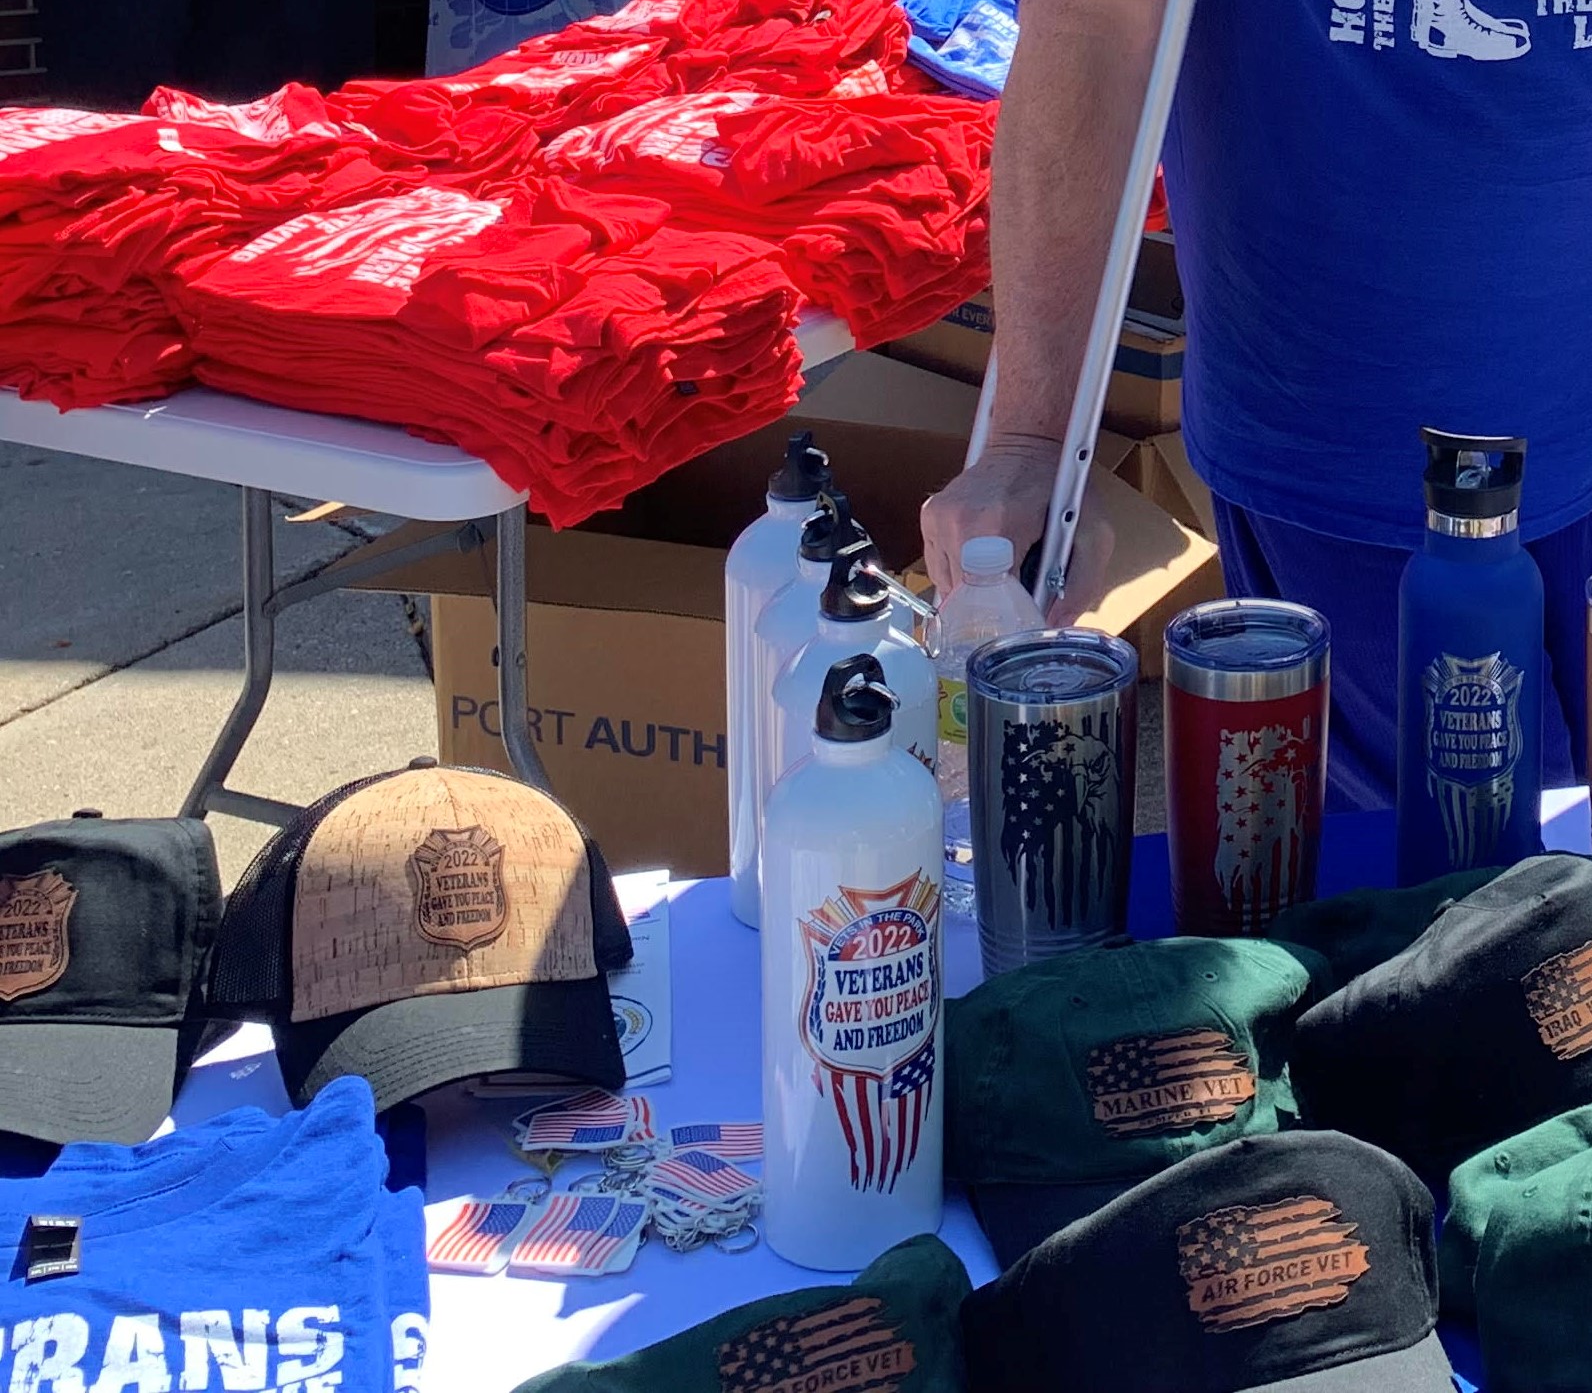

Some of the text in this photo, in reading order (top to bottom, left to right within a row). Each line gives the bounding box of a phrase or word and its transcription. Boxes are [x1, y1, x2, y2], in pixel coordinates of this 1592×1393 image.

[1449, 686, 1492, 706] 2022
[452, 695, 726, 768] PORT AUTH
[1439, 710, 1502, 731] VETERANS
[1433, 730, 1508, 750] GAVE YOU PEACE
[1439, 750, 1503, 769] AND FREEDOM
[444, 850, 478, 869] 2022
[436, 872, 489, 891] VETERANS
[3, 899, 41, 918] 2022
[431, 891, 495, 910] GAVE YOU PEACE
[438, 909, 492, 926] AND FREEDOM
[830, 911, 927, 955] VETS IN THE PARK
[852, 925, 912, 960] 2022
[835, 952, 923, 995] VETERANS
[825, 980, 930, 1023] GAVE YOU PEACE
[833, 1010, 924, 1051] AND FREEDOM
[1544, 1010, 1582, 1039] IRAQ
[1101, 1077, 1242, 1118] MARINE VET
[1202, 1251, 1353, 1303] AIR FORCE VET
[0, 1305, 343, 1393] RANS
[790, 1348, 904, 1393] FORCE VET
